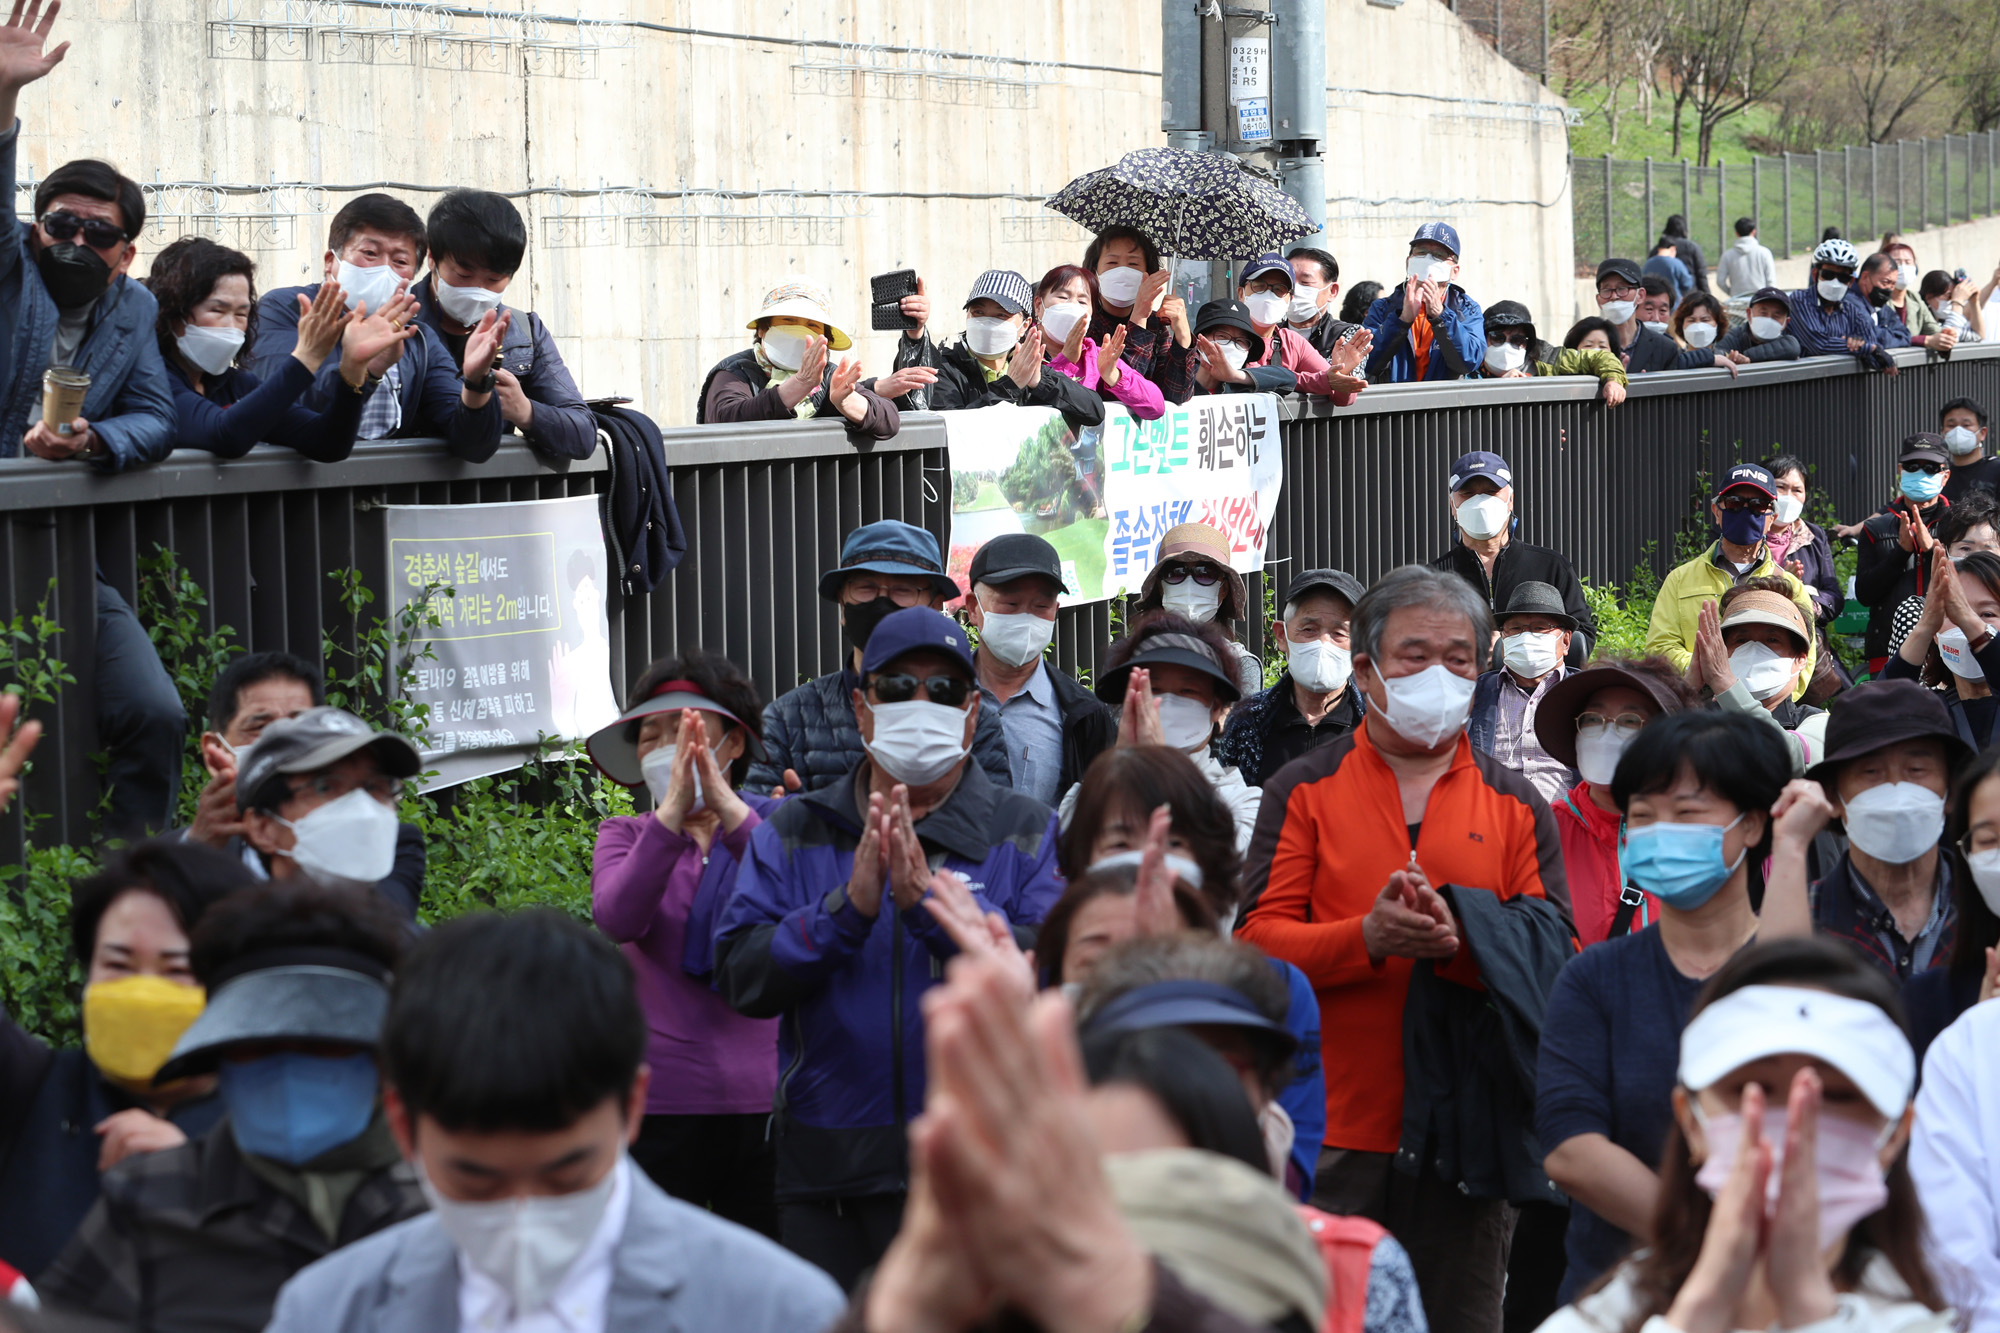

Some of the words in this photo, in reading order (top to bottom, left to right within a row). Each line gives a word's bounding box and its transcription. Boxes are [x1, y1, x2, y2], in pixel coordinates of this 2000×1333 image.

[1232, 46, 1267, 55] 0329H
[1239, 55, 1258, 64] 451
[1243, 66, 1257, 75] 16
[1242, 77, 1257, 86] R5
[1242, 121, 1267, 131] 06-100
[1198, 403, 1266, 471] 훼손하는
[1731, 468, 1768, 484] PING
[404, 552, 451, 586] 경춘선
[454, 551, 509, 584] 숲길에서도
[458, 593, 492, 627] 거리는
[511, 659, 531, 683] 위해
[433, 701, 445, 723] 등
[503, 692, 536, 716] 피하고
